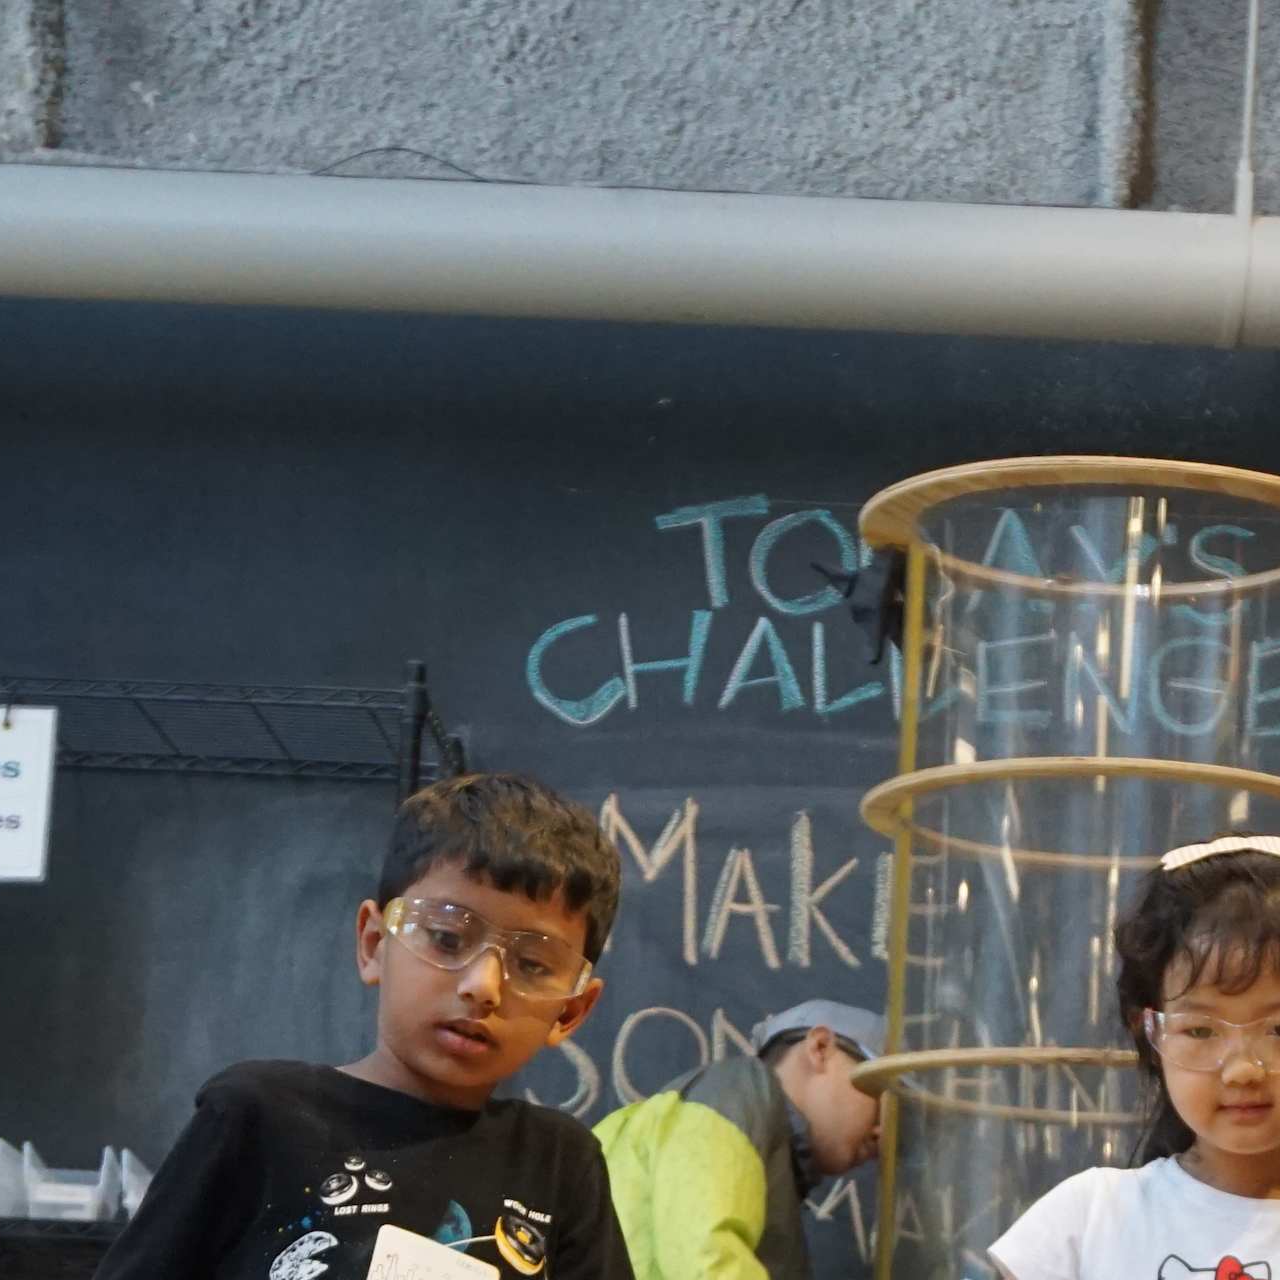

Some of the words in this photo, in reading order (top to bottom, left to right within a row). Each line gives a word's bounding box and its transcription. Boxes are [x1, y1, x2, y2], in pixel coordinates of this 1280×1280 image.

[655, 493, 1256, 626] TOAY'S
[334, 1205, 358, 1216] LOST
[361, 1203, 390, 1214] RINGS
[528, 1210, 552, 1223] HOLE
